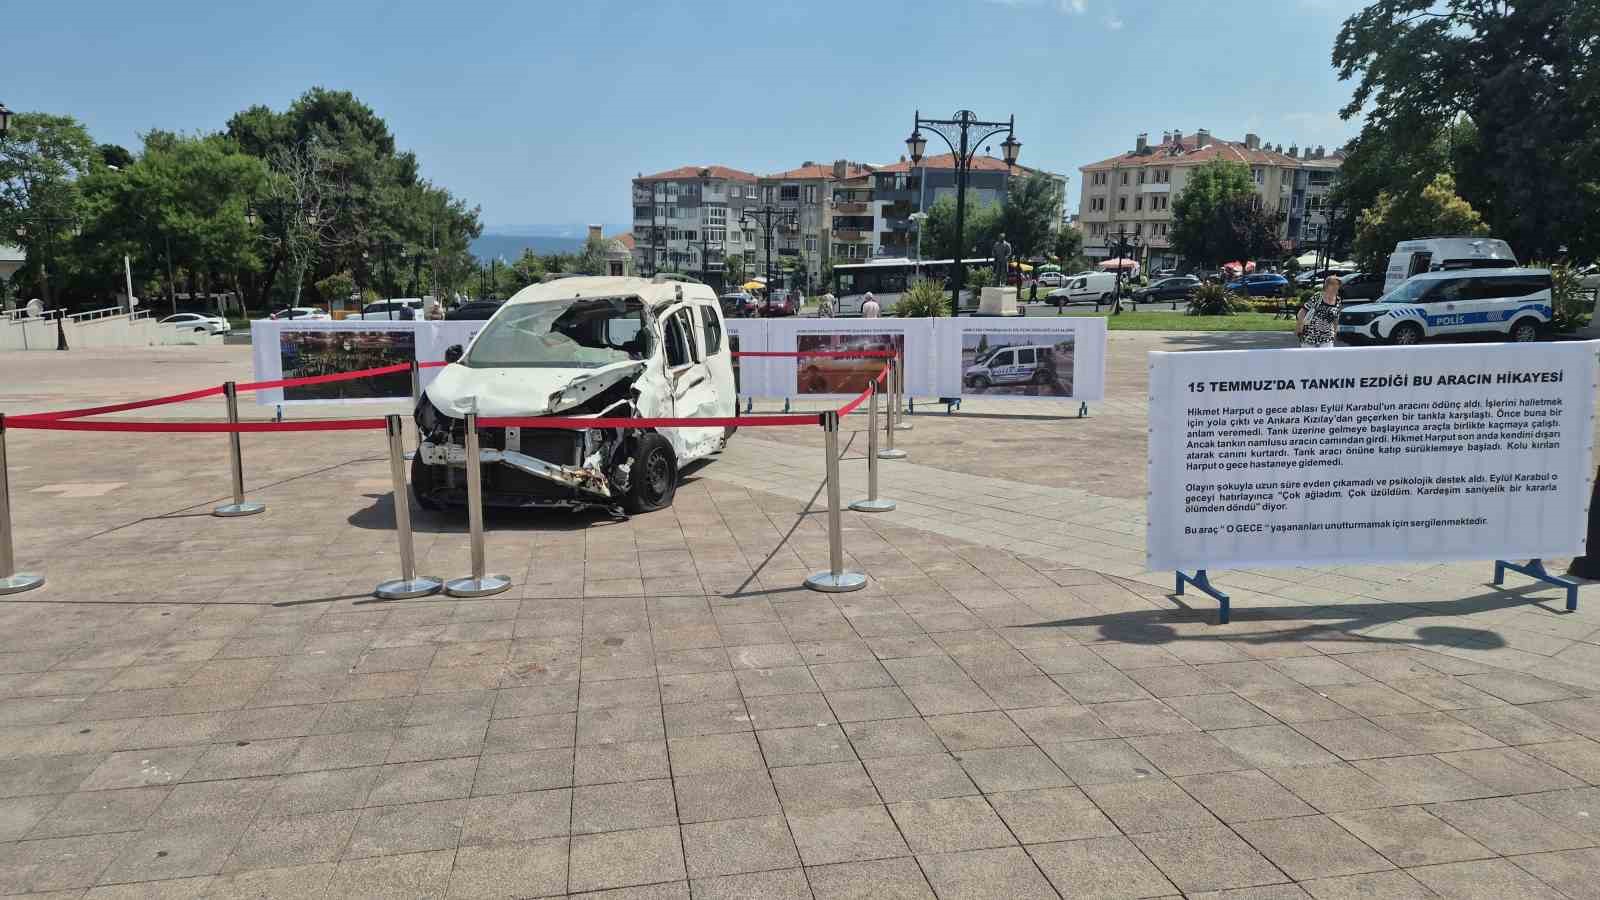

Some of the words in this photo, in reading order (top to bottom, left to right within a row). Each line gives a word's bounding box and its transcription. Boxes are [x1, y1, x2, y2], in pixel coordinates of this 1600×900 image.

[1436, 312, 1465, 326] POLİS
[1188, 382, 1205, 392] 15
[1210, 380, 1296, 392] TEMMUZ'DA
[1301, 378, 1355, 389] TANKIN
[1360, 375, 1408, 388] EZDİĞİ
[1413, 376, 1432, 386] BU
[1437, 374, 1492, 386] ARACIN
[1497, 370, 1563, 384] HİKAYESİ
[1187, 406, 1220, 416] Hikmet
[1223, 405, 1254, 417] Harput
[1266, 407, 1287, 416] gece
[1290, 404, 1318, 413] ablası
[1321, 403, 1343, 414] Eylül
[1346, 402, 1395, 411] Karabul'un
[1432, 400, 1463, 411] ödünç
[1486, 398, 1516, 410] İşlerini
[1520, 397, 1562, 407] halletmek
[1187, 418, 1204, 429] için
[1207, 417, 1226, 429] yola
[1230, 416, 1249, 428] çıktı
[1268, 415, 1300, 424] Ankara
[1304, 413, 1353, 425] Kızılay'dan
[1357, 412, 1398, 424] geçerken
[1402, 411, 1414, 420] bir
[1418, 411, 1445, 420] tankla
[1449, 409, 1493, 421] karşılaştı.
[1497, 408, 1521, 418] Önce
[1524, 408, 1546, 417] buna
[1550, 407, 1562, 416] bir
[1187, 428, 1214, 437] anlam
[1218, 427, 1262, 436] veremedi.
[1268, 426, 1289, 435] Tank
[1292, 425, 1325, 434] üzerine
[1329, 424, 1367, 436] gelmeye
[1371, 423, 1419, 434] başlayınca
[1423, 421, 1450, 433] araçla
[1454, 420, 1485, 430] birlikte
[1488, 420, 1528, 431] kaçmaya
[1531, 418, 1560, 430] çalıştı.
[1187, 439, 1214, 448] Ancak
[1217, 438, 1246, 447] tankın
[1248, 437, 1287, 447] namlusu
[1392, 433, 1423, 442] Hikmet
[1425, 432, 1456, 443] Harput
[1477, 431, 1498, 440] anda
[1501, 430, 1533, 439] kendini
[1187, 449, 1214, 459] atarak
[1251, 447, 1289, 457] kurtardı.
[1294, 446, 1315, 456] Tank
[1346, 445, 1375, 454] önüne
[1379, 444, 1401, 455] katıp
[1405, 443, 1463, 454] sürüklemeye
[1468, 441, 1502, 453] başladı.
[1507, 441, 1528, 450] Kolu
[1187, 460, 1216, 472] Harput
[1226, 462, 1248, 471] gece
[1250, 459, 1297, 470] hastaneye
[1299, 457, 1343, 469] gidemedi.
[1186, 482, 1214, 493] Olayın
[1217, 481, 1253, 493] şokuyla
[1280, 479, 1301, 488] süre
[1303, 479, 1330, 488] evden
[1333, 477, 1374, 489] çıkamadı
[1389, 475, 1433, 488] psikolojik
[1436, 474, 1466, 484] destek
[1490, 473, 1512, 485] Eylül
[1186, 492, 1215, 504] geceyi
[1220, 491, 1273, 502] hatırlayınca
[1305, 489, 1343, 501] ağladım.
[1348, 488, 1367, 499] Çok
[1417, 485, 1460, 497] Kardeşim
[1465, 484, 1505, 496] saniyelik
[1510, 484, 1522, 493] bir
[1526, 483, 1557, 492] kararla
[1186, 503, 1225, 512] ölümden
[1262, 501, 1288, 513] diyor.
[1185, 525, 1197, 534] Bu
[1199, 527, 1218, 536] araç
[1226, 524, 1234, 533] O
[1236, 523, 1262, 532] GECE
[1325, 519, 1390, 530] unutturmamak
[1392, 518, 1408, 530] için
[1410, 516, 1488, 529] sergilenmektedir.
